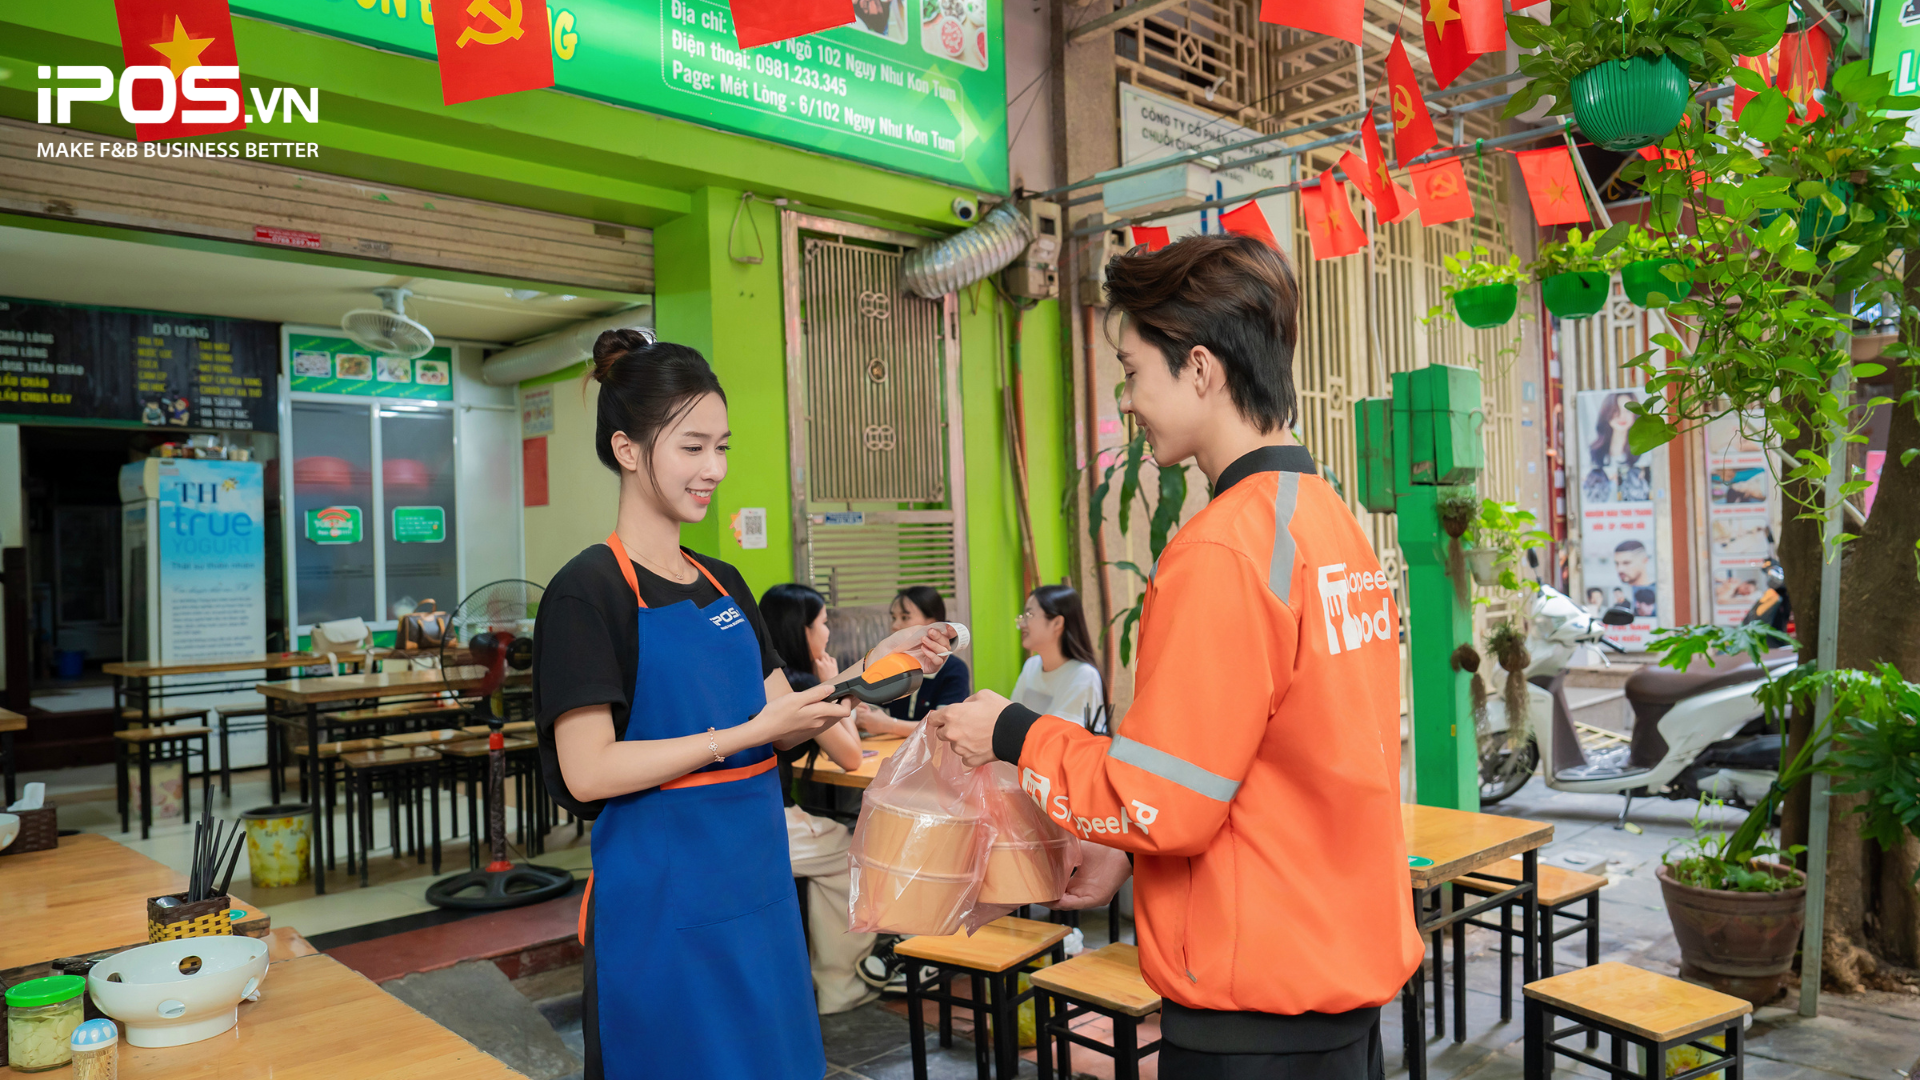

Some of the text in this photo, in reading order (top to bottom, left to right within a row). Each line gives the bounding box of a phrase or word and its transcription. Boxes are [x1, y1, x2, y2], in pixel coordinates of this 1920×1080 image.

[672, 29, 847, 97] Điện thoại: 0981.233.345
[701, 11, 727, 34] chỉ:
[817, 44, 841, 68] 102
[845, 52, 876, 81] Ngụy
[880, 63, 903, 87] Như
[907, 72, 929, 94] Kon
[932, 80, 956, 102] Tum
[672, 59, 715, 91] Page:
[720, 73, 749, 99] Mét
[753, 82, 787, 112] Lòng
[799, 95, 840, 122] 6/102
[844, 107, 876, 135] Ngụy
[879, 117, 903, 139] Như
[906, 124, 928, 145] Kon
[931, 130, 955, 153] Tum
[1141, 107, 1170, 126] CÔNG
[1173, 118, 1185, 131] TY
[174, 482, 217, 503] TH
[173, 506, 253, 537] true
[172, 537, 250, 555] YOGURT
